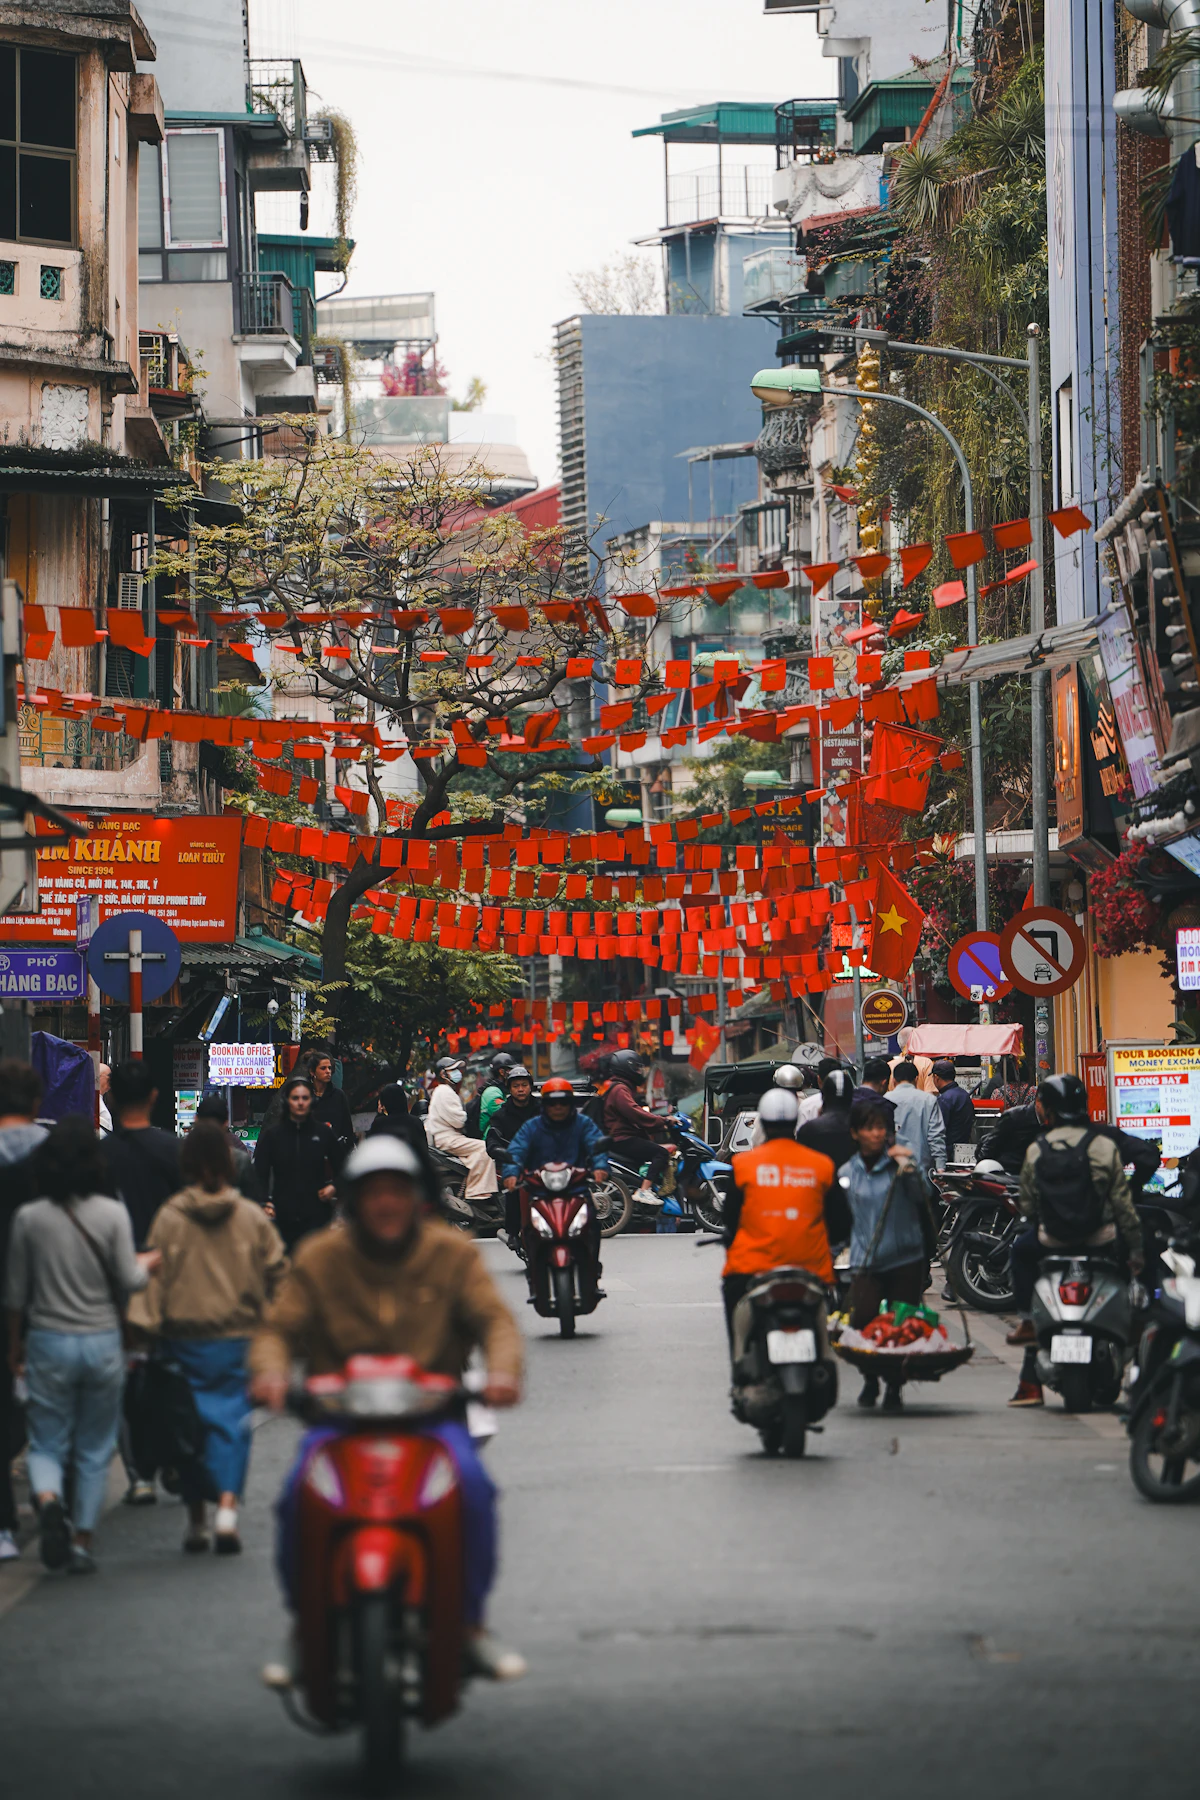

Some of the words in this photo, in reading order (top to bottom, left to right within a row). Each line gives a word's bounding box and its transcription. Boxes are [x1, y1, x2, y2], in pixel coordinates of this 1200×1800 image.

[824, 739, 859, 747] RESTAURANT
[837, 748, 846, 757] &
[832, 758, 852, 766] DRINKS
[97, 819, 121, 831] VÀNG
[123, 822, 140, 832] BẠC
[74, 832, 161, 863] KHÁNH
[178, 852, 200, 863] LOAN
[202, 850, 225, 864] THỦY
[68, 866, 93, 875] SINCE
[94, 866, 114, 876] 1994
[55, 876, 73, 888] VÀNG
[75, 877, 86, 890] CŨ,
[104, 879, 118, 890] 10K,
[54, 891, 67, 904] TÁC
[104, 892, 120, 905] SỨC,
[148, 895, 164, 904] THEO
[166, 896, 188, 905] PHONG
[189, 892, 206, 905] THỦY
[27, 954, 58, 966] PHỐ
[1181, 961, 1194, 973] SIM
[0, 970, 41, 991] HÀNG
[46, 974, 77, 995] BẠC
[212, 1046, 244, 1055] BOOKING
[247, 1046, 271, 1055] OFFICE
[1116, 1050, 1144, 1058] TOUR
[1148, 1048, 1195, 1057] BOOKING
[211, 1057, 234, 1066] MONEY
[237, 1057, 272, 1066] EXCHANGE
[1117, 1078, 1131, 1086] HA
[1133, 1077, 1160, 1085] LONG
[1161, 1076, 1182, 1085] BAY
[1119, 1119, 1144, 1127] NINH
[1146, 1118, 1170, 1126] BINH
